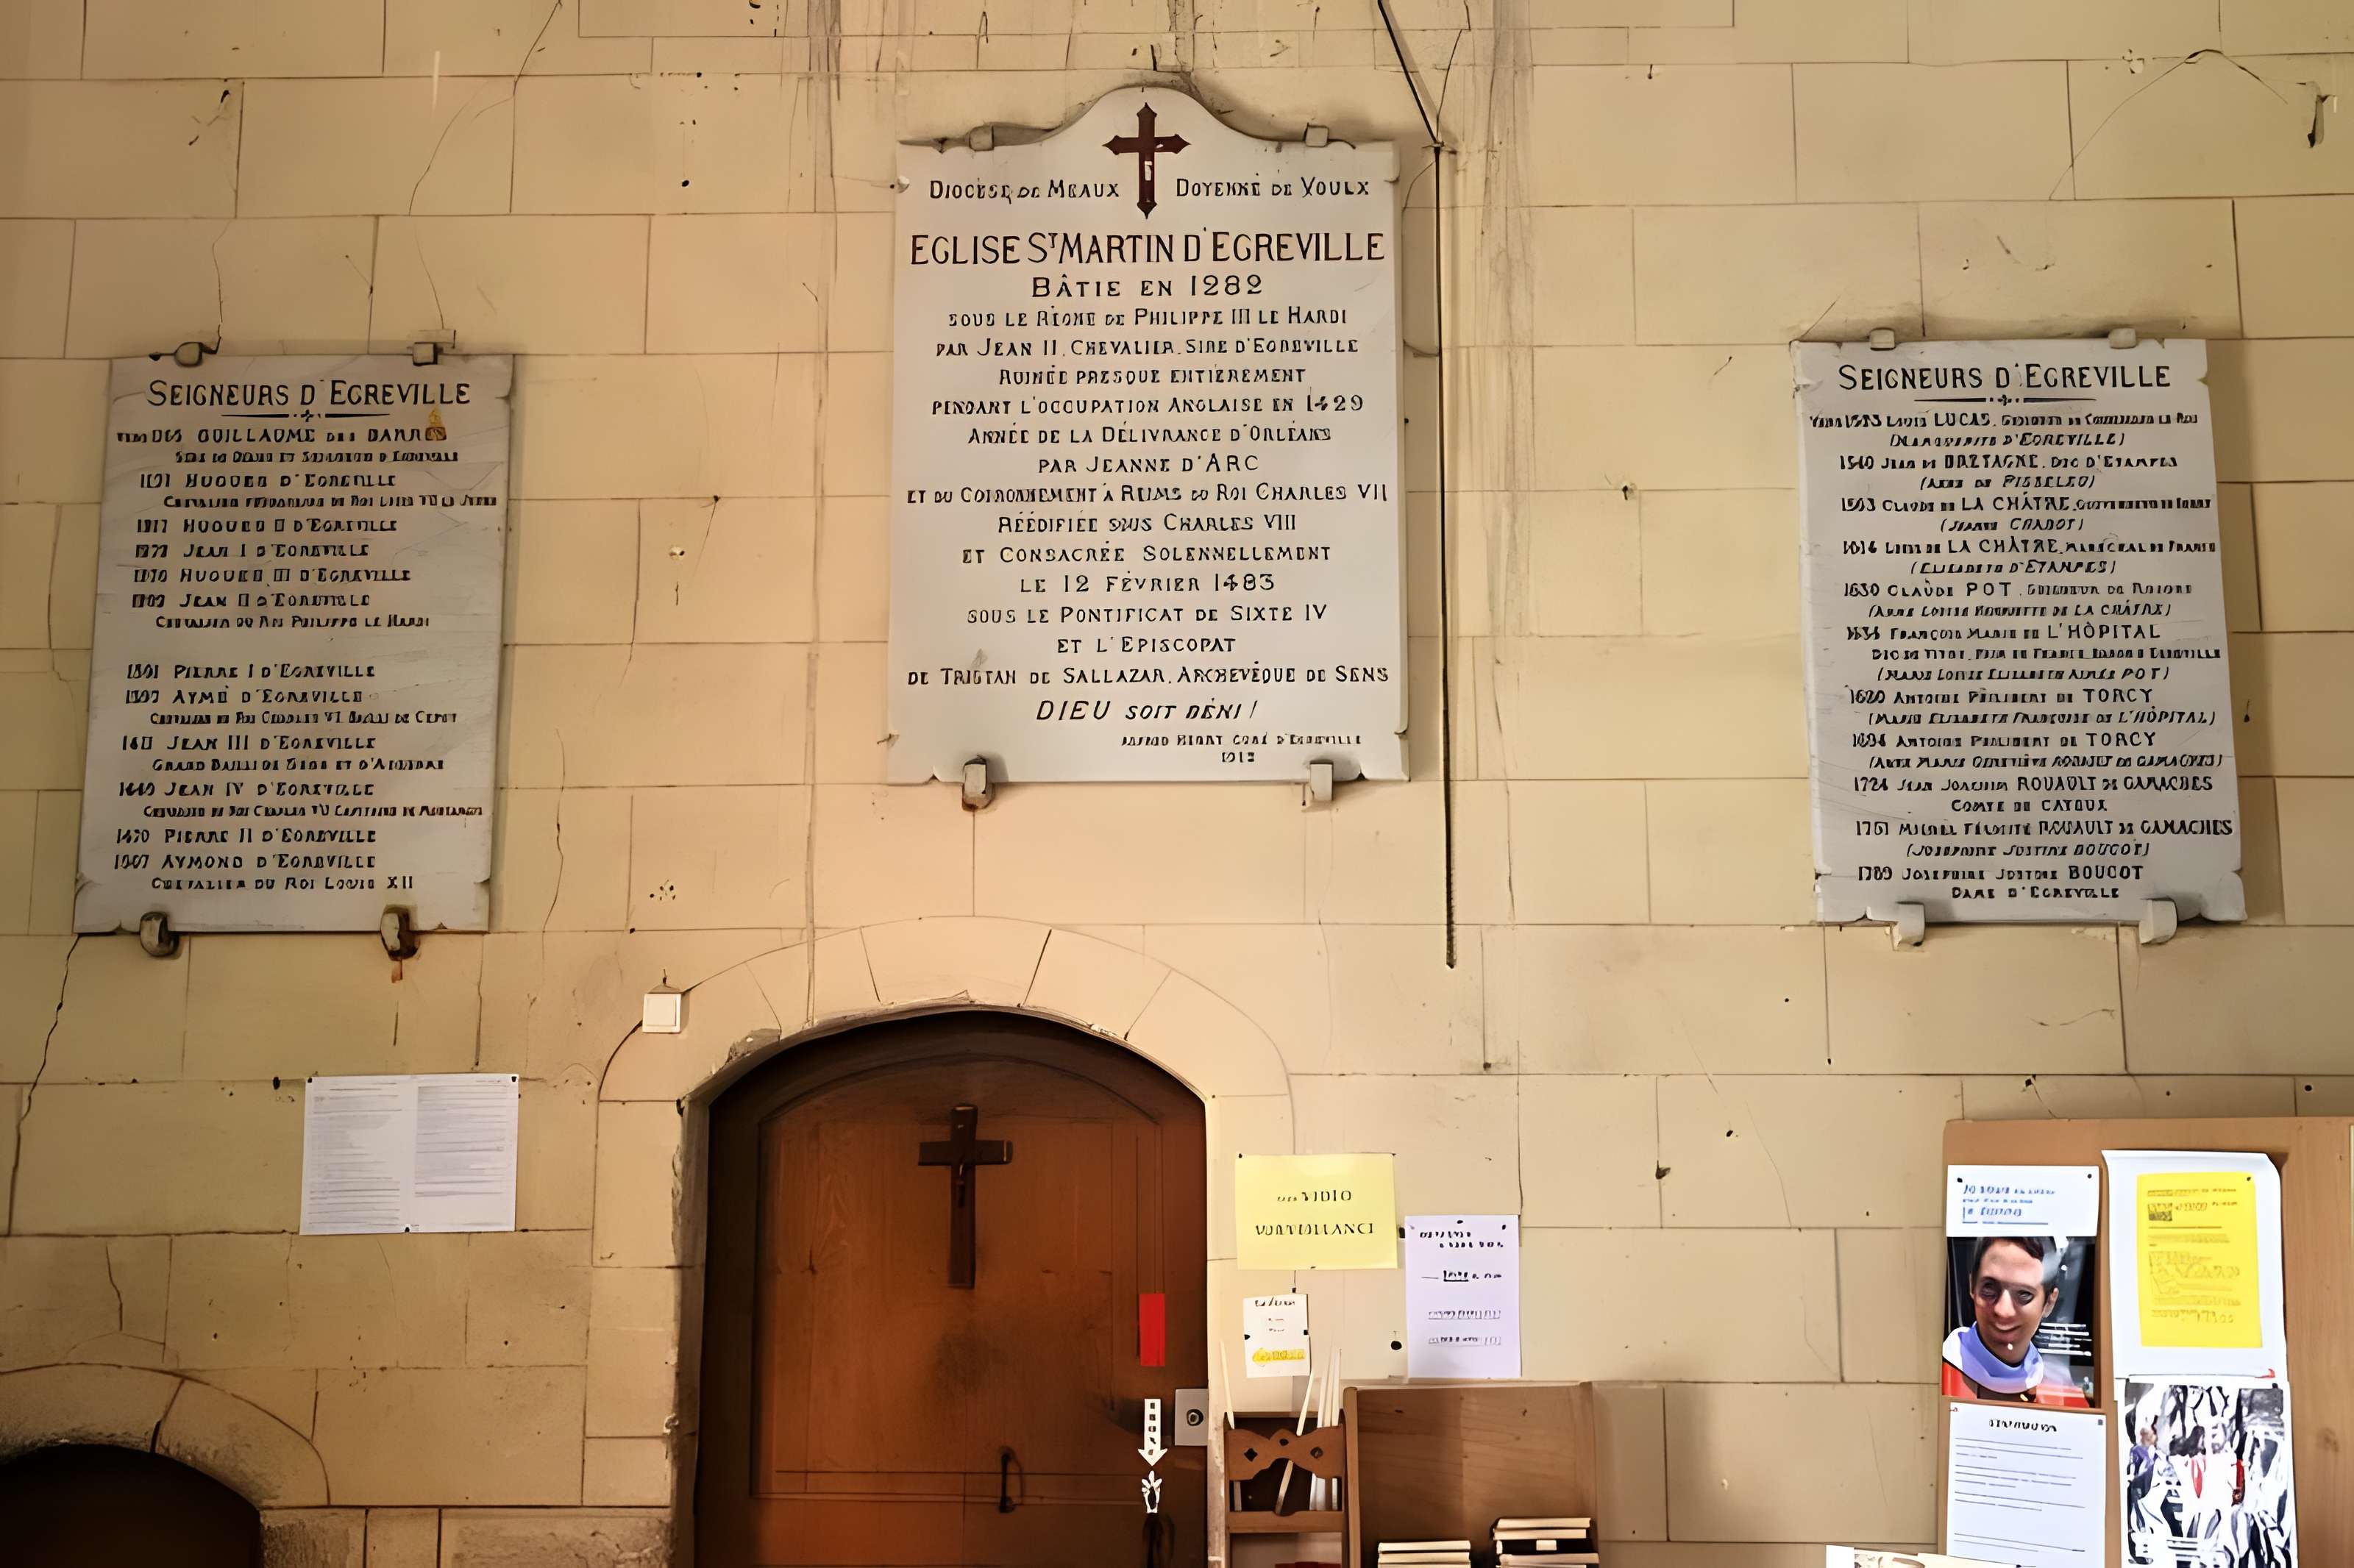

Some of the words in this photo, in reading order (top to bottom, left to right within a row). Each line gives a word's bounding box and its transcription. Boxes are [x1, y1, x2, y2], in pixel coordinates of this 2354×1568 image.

[1016, 186, 1040, 199] DE
[1047, 179, 1120, 199] MEAUX
[1176, 172, 1261, 197] DOYENNÉ
[1271, 183, 1292, 196] DE
[911, 234, 1021, 266] EGLISE
[1058, 232, 1174, 264] MARTIN
[1031, 273, 1120, 298] BÂTIE
[1140, 279, 1172, 296] EN
[1191, 274, 1262, 296] 1282
[948, 313, 995, 327] SOUS
[1006, 312, 1028, 327] LE
[1105, 313, 1125, 327] DE
[1134, 307, 1223, 326] PHILIPPE
[1231, 308, 1251, 325] III
[1259, 310, 1279, 324] LE
[1288, 305, 1346, 324] HARDI
[936, 343, 969, 357] PAR
[976, 338, 1032, 357] JEAN
[1076, 369, 1160, 385] PRESQUE
[1838, 364, 1983, 391] SEIGNEURS
[146, 379, 289, 407] SEIGNEURS
[931, 400, 1011, 416] PENDANT
[1020, 396, 1159, 415] L'OCCUPATION
[1167, 396, 1263, 413] ANGLAISE
[1272, 397, 1294, 412] EN
[1306, 394, 1363, 413] 1429
[1038, 430, 1060, 444] DE
[1070, 429, 1093, 443] LA
[1038, 458, 1077, 474] PAR
[1086, 455, 1170, 473] JEANNE
[1181, 452, 1259, 473] D'ARC
[907, 489, 927, 504] ET
[1216, 483, 1246, 502] ROI
[1256, 482, 1347, 501] CHARLES
[1357, 483, 1387, 502] VII
[1961, 496, 1984, 511] LA
[1164, 513, 1254, 532] CHARLES
[1263, 513, 1295, 531] VIII
[962, 549, 985, 564] ET
[1000, 541, 1125, 563] CONSACRÉE
[1143, 544, 1331, 562] SOLENNELLEMENT
[1947, 539, 1971, 554] LA
[1020, 578, 1046, 593] LE
[1064, 574, 1089, 593] 12
[1106, 570, 1200, 593] FÉVRIER
[1215, 573, 1275, 592] 1483
[967, 609, 1016, 624] SOUS
[1027, 609, 1049, 624] LE
[1061, 606, 1184, 624] PONTIFICAT
[1195, 608, 1218, 621] DE
[1231, 605, 1292, 621] SIXTE
[1306, 604, 1327, 621] IV
[1057, 638, 1082, 654] ET
[907, 671, 929, 685] DE
[1030, 671, 1050, 685] DE
[1306, 669, 1326, 683] DE
[1335, 665, 1389, 683] SENS
[2083, 688, 2153, 703] TORCY
[1036, 699, 1112, 721] DIEU
[1125, 705, 1177, 720] SOIT
[2085, 731, 2156, 747] TORCY
[161, 854, 243, 870] AYMOND
[2068, 864, 2144, 880] BOUCOT
[284, 877, 315, 891] ROI
[386, 875, 413, 890] XII
